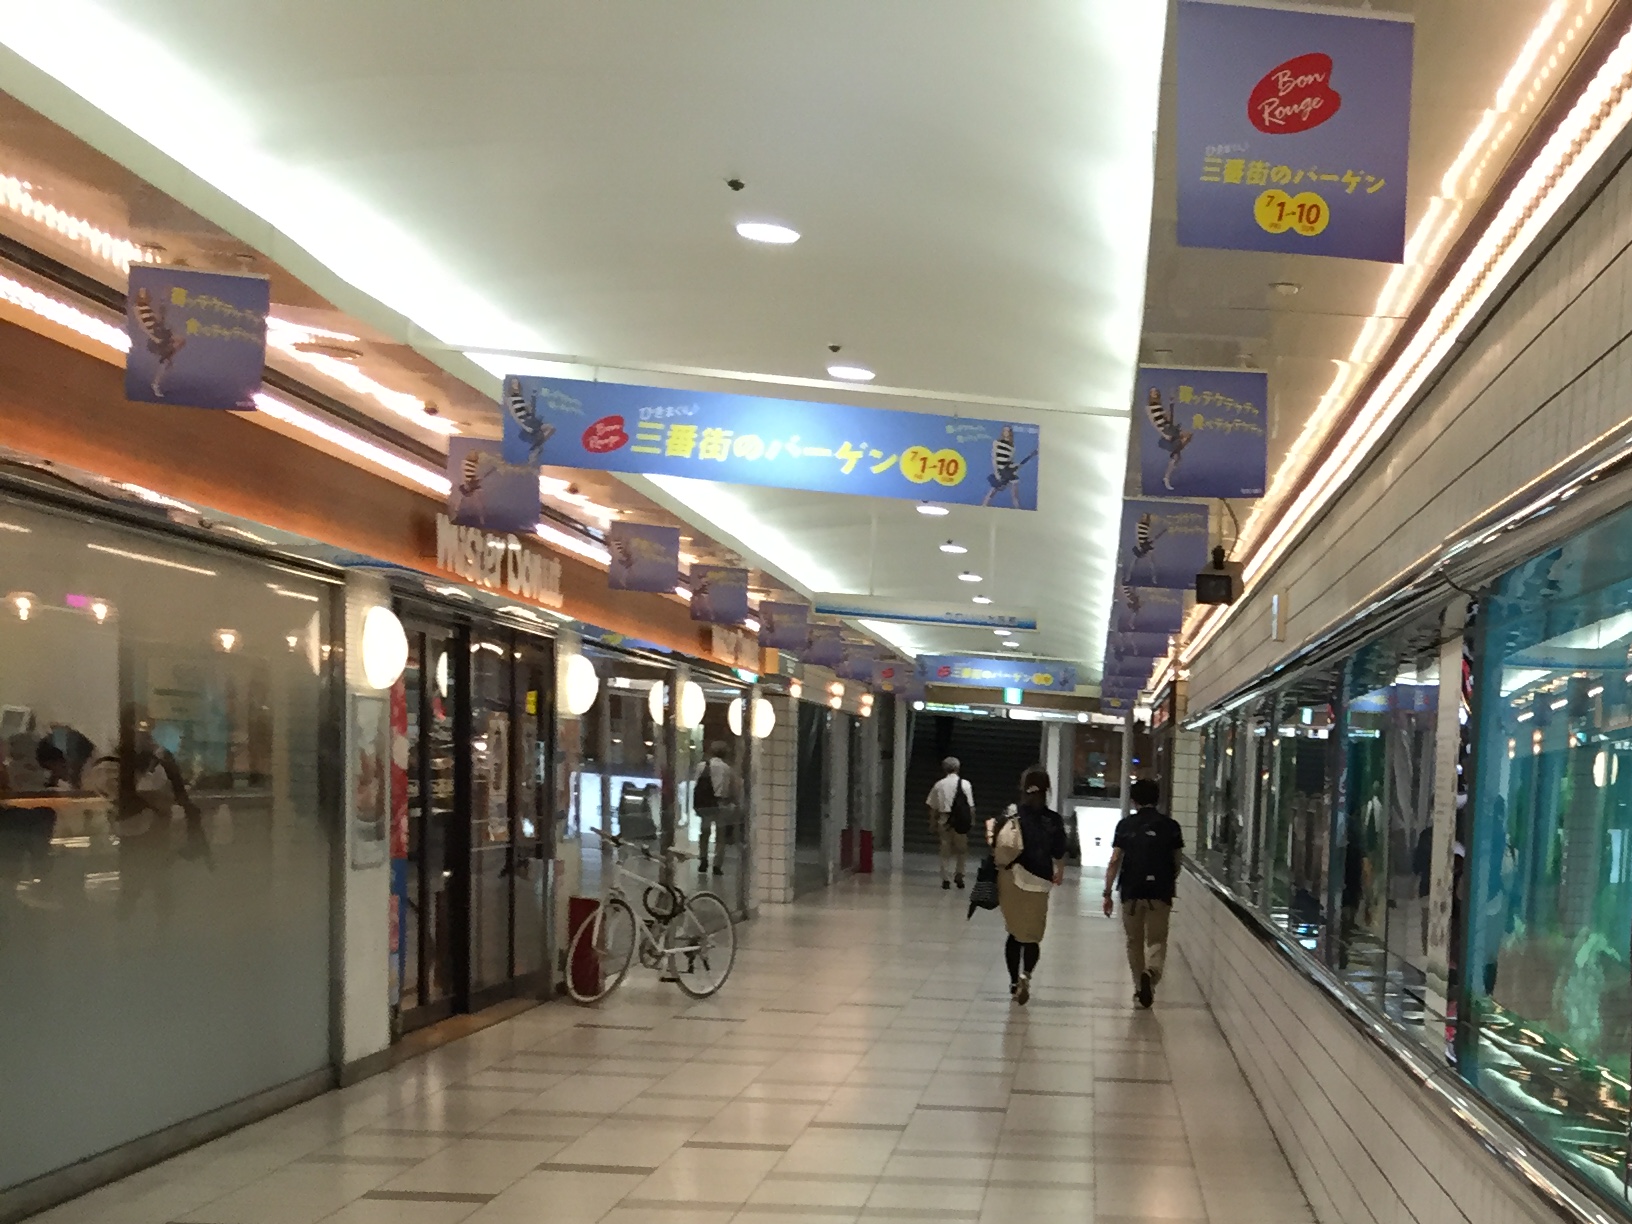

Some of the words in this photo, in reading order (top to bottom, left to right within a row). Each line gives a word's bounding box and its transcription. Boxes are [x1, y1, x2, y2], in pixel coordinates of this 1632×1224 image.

[1271, 69, 1326, 97] Bon
[1257, 96, 1325, 127] Rouge
[1200, 156, 1386, 194] 三番街のバーゲン
[630, 420, 897, 475] 三番街のバーゲン
